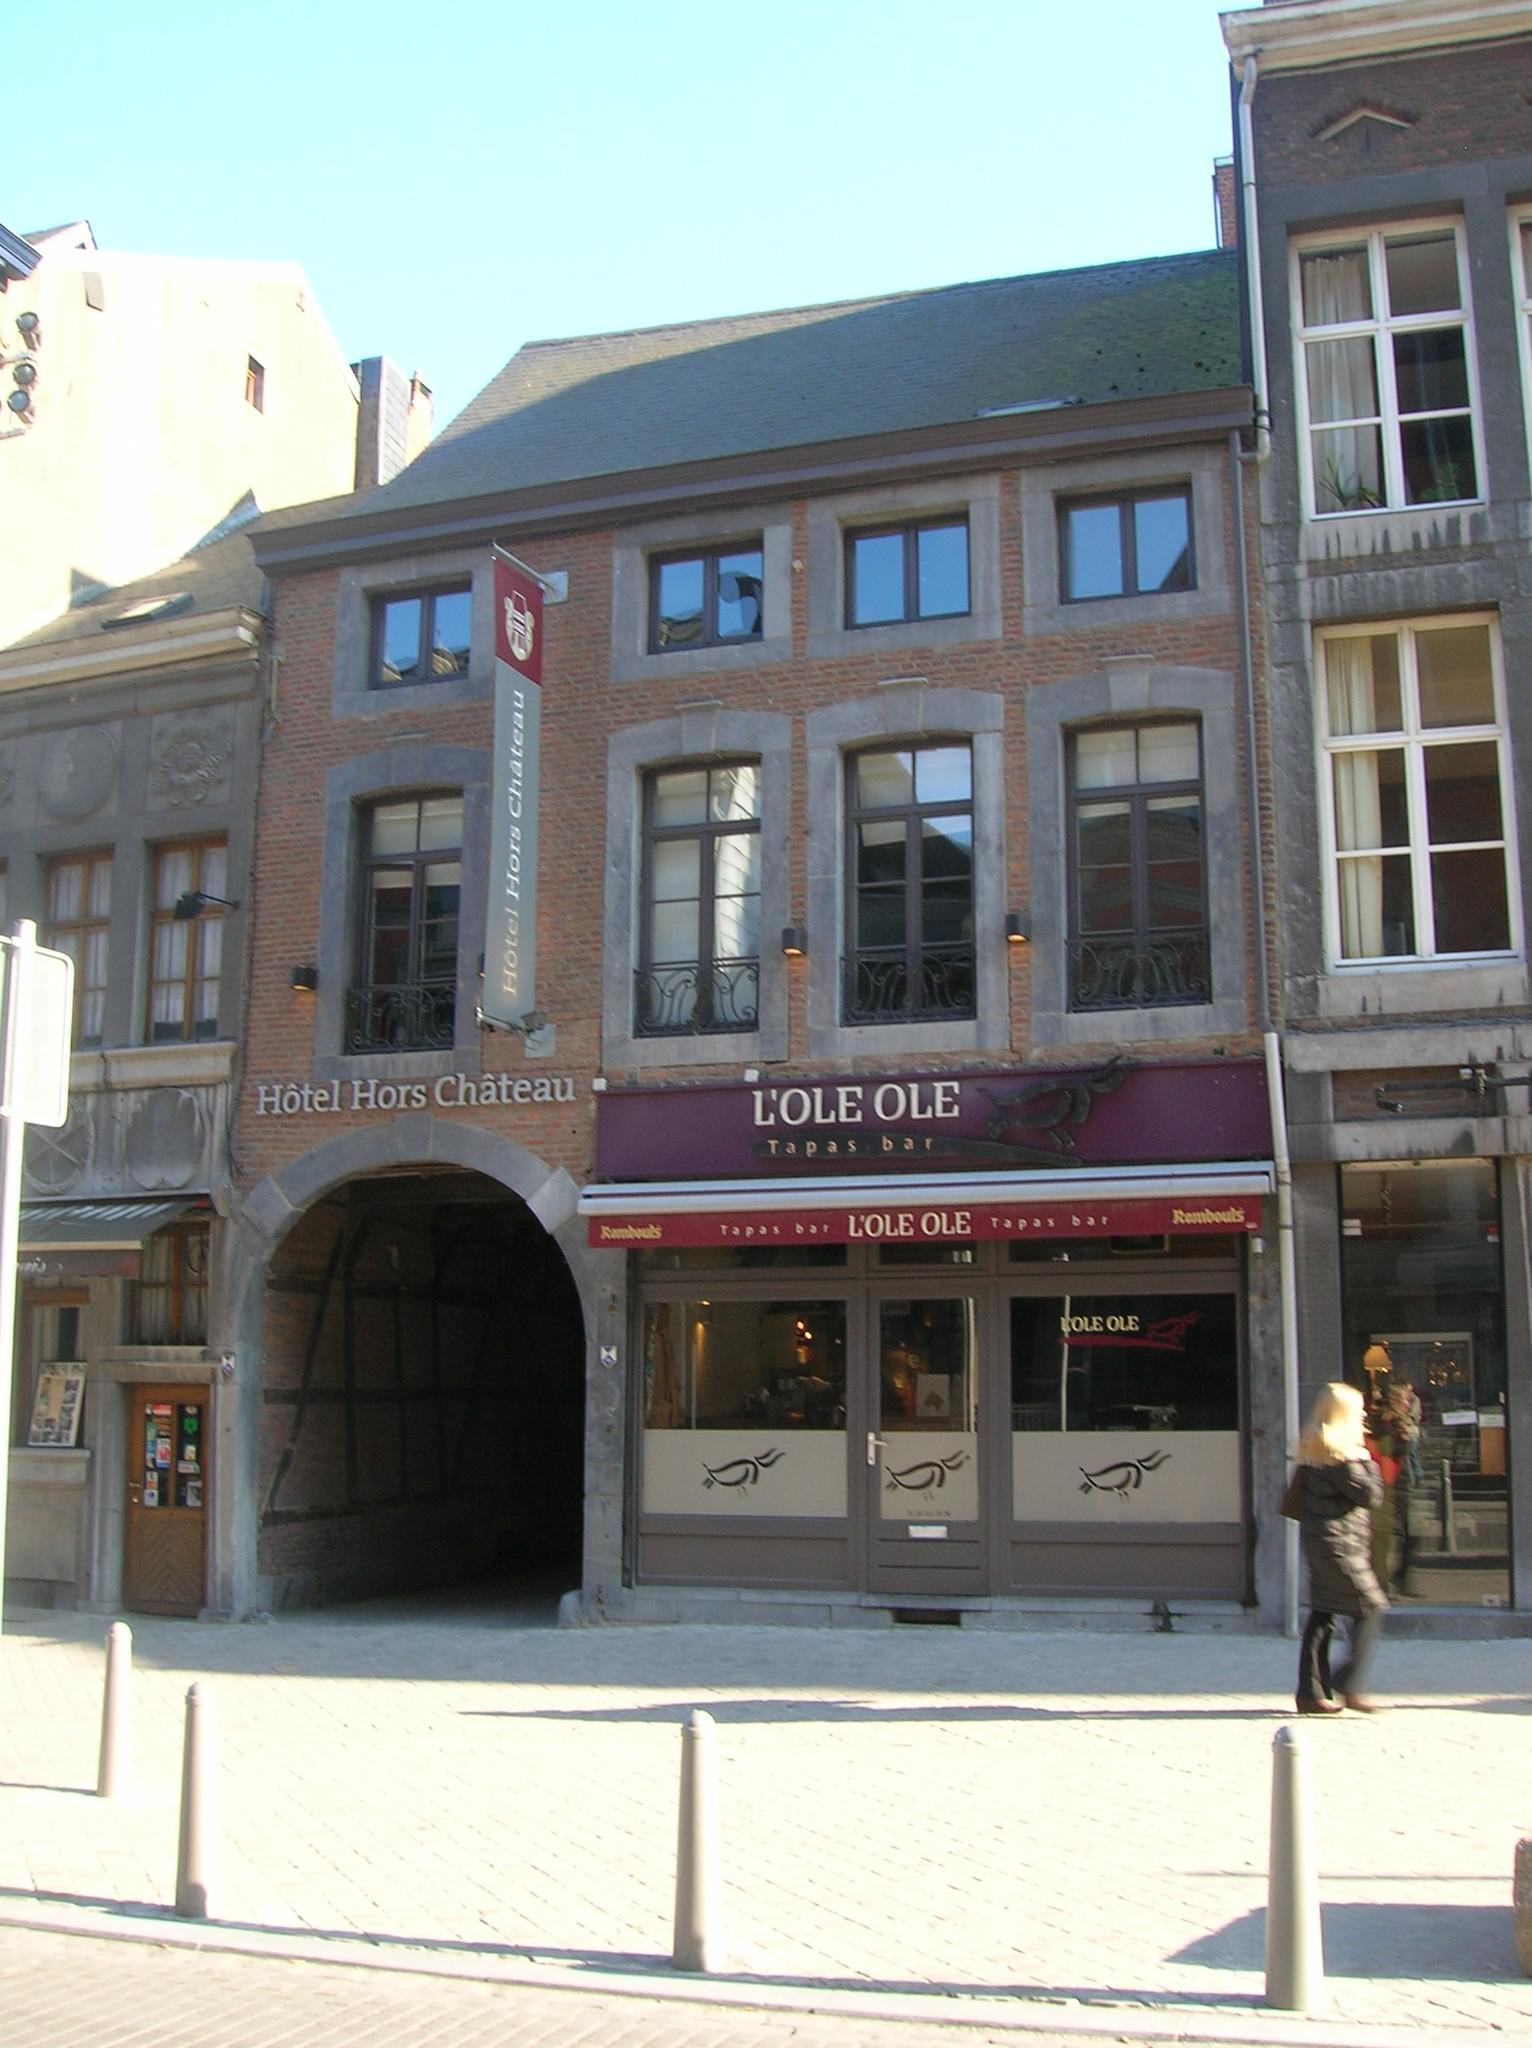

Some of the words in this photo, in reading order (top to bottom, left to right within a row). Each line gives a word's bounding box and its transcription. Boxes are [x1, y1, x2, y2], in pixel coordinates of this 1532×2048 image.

[506, 689, 525, 819] Château
[505, 825, 522, 901] Hors
[502, 906, 519, 997] Hôtel
[255, 1080, 341, 1115] Hôtel
[351, 1079, 427, 1111] Hors
[434, 1073, 577, 1107] Château
[752, 1086, 863, 1126] L'OLE
[874, 1081, 960, 1121] OLE
[767, 1138, 858, 1157] Tapas
[881, 1135, 934, 1151] bar
[719, 1223, 781, 1238] Tapas
[795, 1222, 830, 1236] bar
[848, 1213, 914, 1238] L'OLE
[920, 1211, 972, 1236] OLE
[990, 1216, 1056, 1231] Tapas
[1071, 1214, 1109, 1227] bar
[1105, 1315, 1140, 1332] OLE
